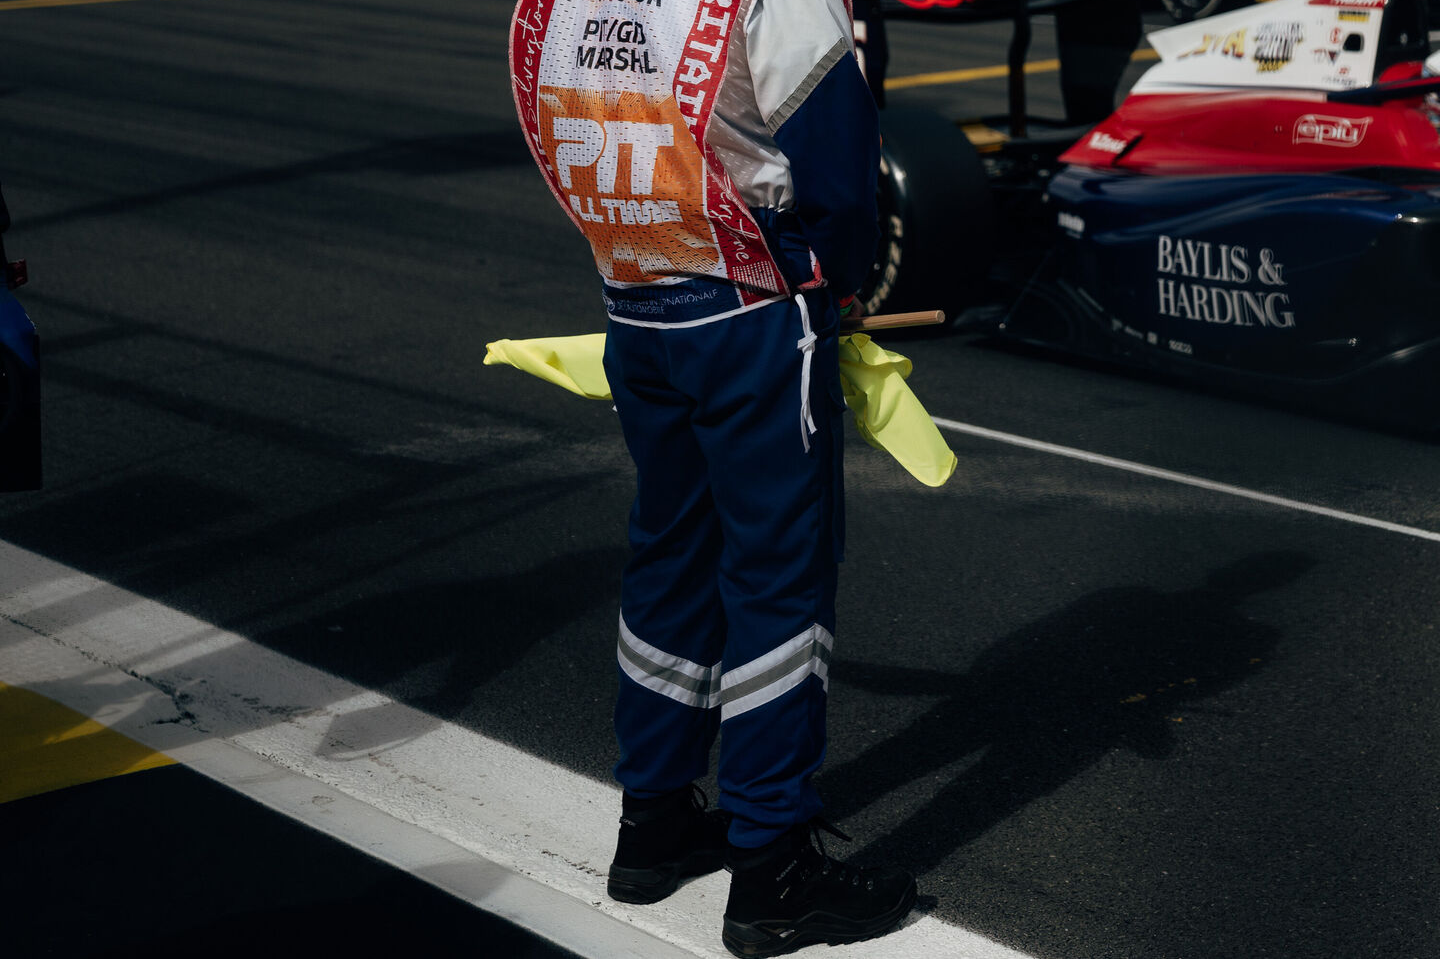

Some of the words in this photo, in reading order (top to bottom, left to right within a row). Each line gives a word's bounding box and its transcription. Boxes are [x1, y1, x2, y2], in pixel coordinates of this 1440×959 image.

[1157, 235, 1250, 284] BAYLIS
[1257, 247, 1288, 286] &
[1157, 278, 1296, 329] HARDING
